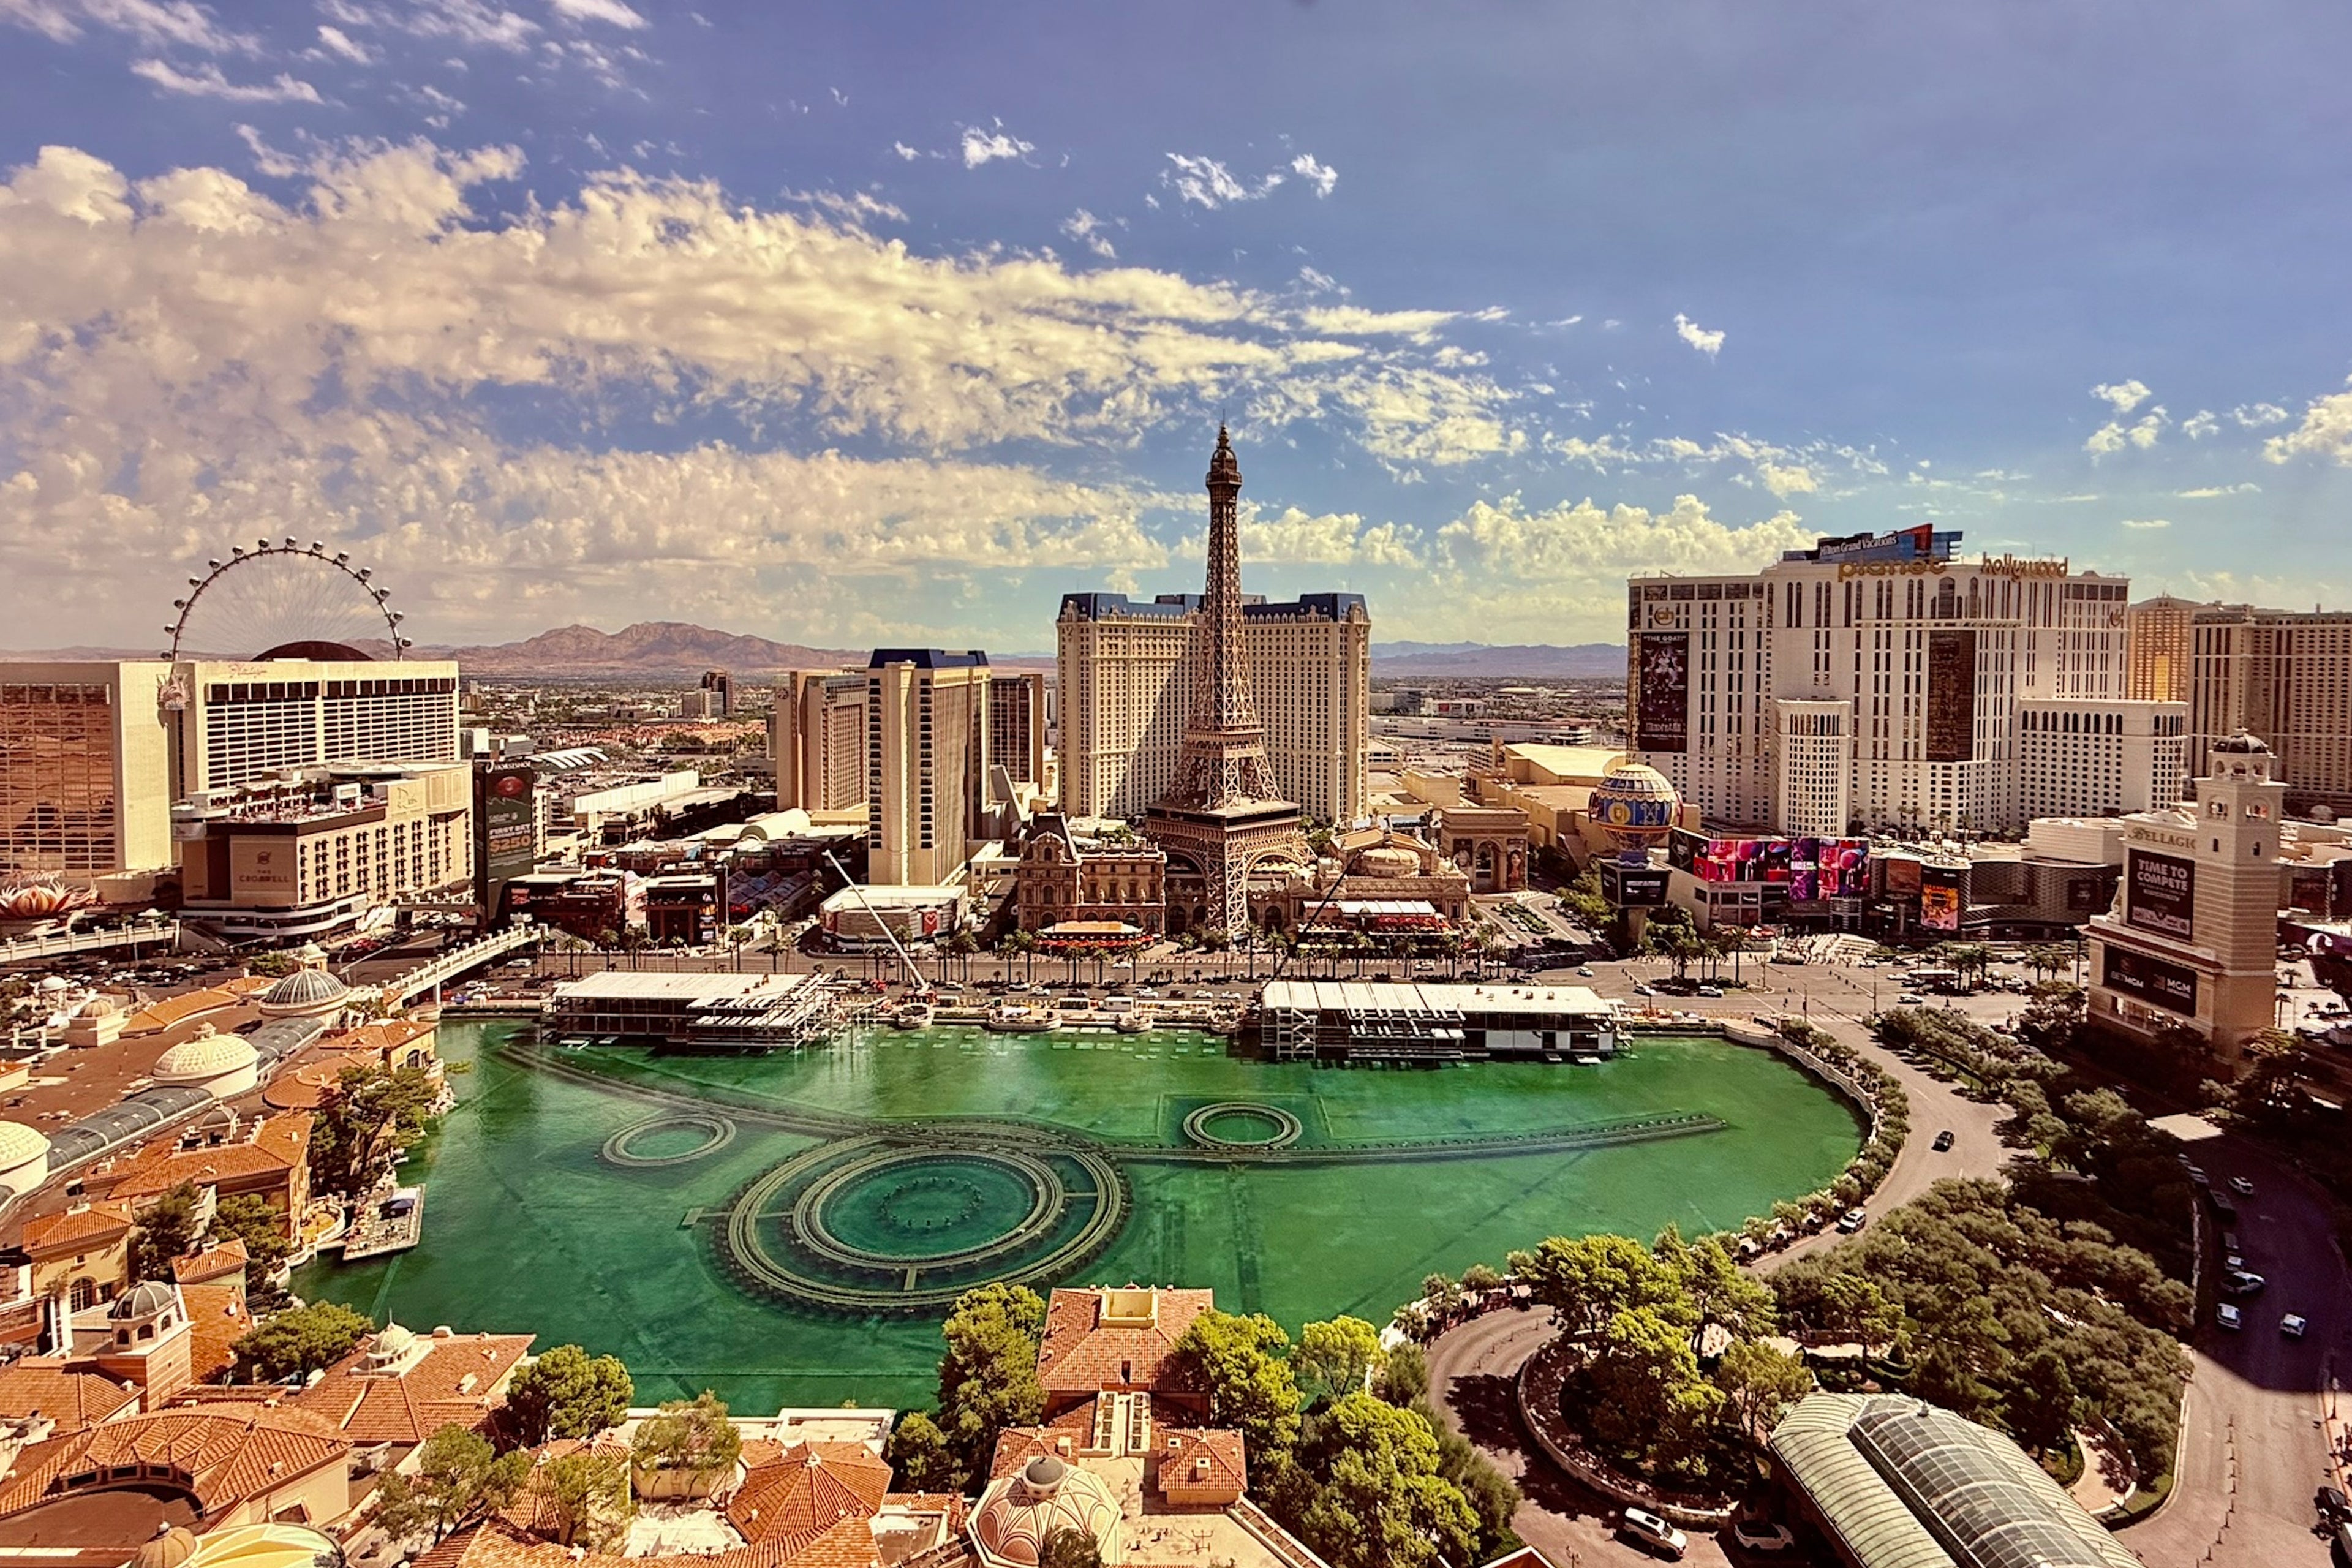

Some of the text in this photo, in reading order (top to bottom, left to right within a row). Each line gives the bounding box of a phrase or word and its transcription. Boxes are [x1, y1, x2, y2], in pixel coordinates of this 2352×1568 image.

[1841, 539, 1861, 552] Grand
[1862, 535, 1897, 549] Vacations
[1838, 551, 2068, 582] planet hollywood
[494, 761, 532, 771] HORSESHOE
[489, 826, 514, 835] FIRST
[489, 835, 532, 853] $250
[2138, 859, 2188, 880] TIME TO
[2136, 871, 2188, 891] COMPETE
[2166, 978, 2192, 993] MGM
